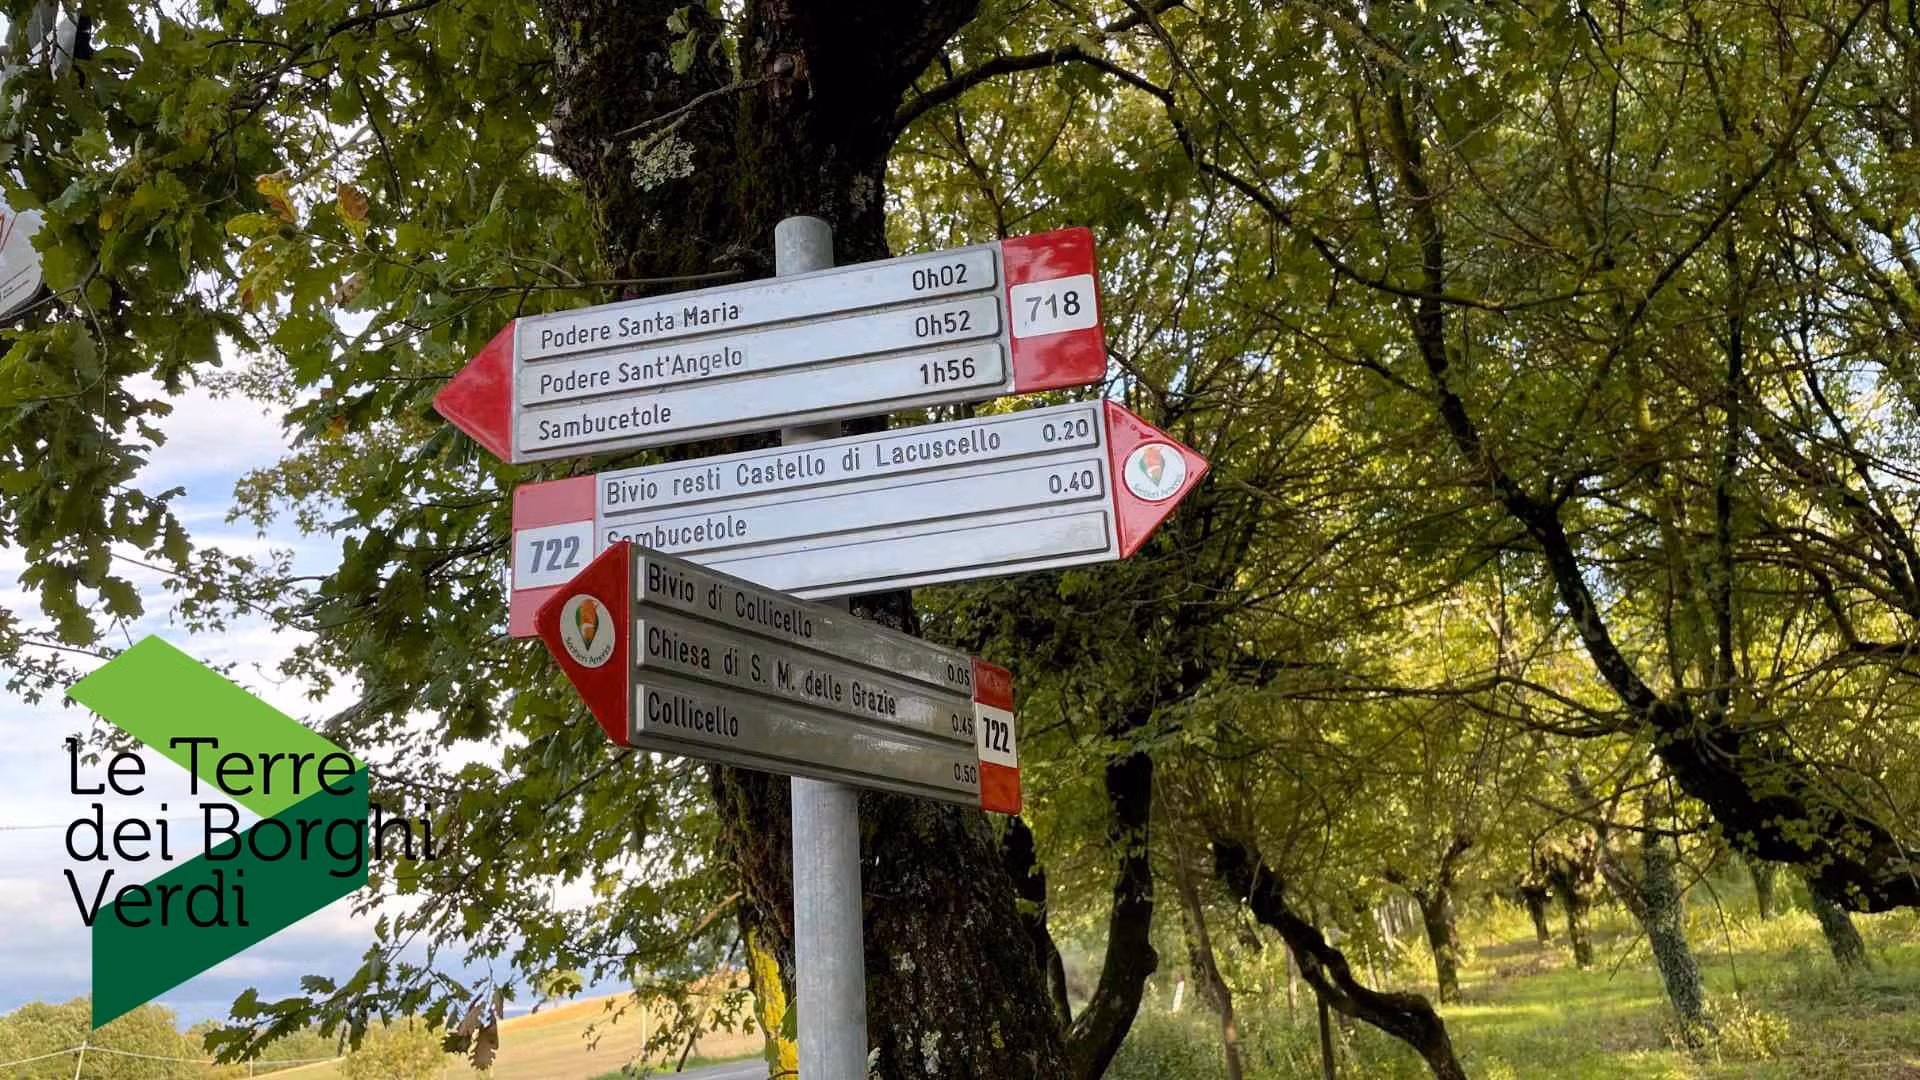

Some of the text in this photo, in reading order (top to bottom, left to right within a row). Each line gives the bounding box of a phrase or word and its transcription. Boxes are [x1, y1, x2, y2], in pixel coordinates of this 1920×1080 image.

[912, 263, 968, 291] 0h02
[915, 310, 971, 338] 0h52
[1025, 291, 1081, 323] 718
[541, 302, 740, 350] Podere Santa Maria
[540, 348, 742, 395] Podere Sant'Angelo
[920, 357, 976, 385] 1h56
[538, 404, 672, 441] Sambucetole
[1042, 418, 1089, 442] 0.20
[607, 428, 1001, 505] Bivio resti Castello di Lacuscello
[1049, 470, 1094, 494] 0.40
[530, 535, 580, 574] 722
[648, 563, 812, 639] Bivio di Collicello
[649, 628, 711, 670] Chiesa
[724, 648, 738, 676] di
[751, 654, 767, 684] S.
[778, 661, 796, 691] M.
[805, 670, 842, 702] delle
[852, 682, 897, 716] Grazie
[947, 664, 970, 686] 0.05
[649, 692, 739, 737] Collicello
[952, 713, 974, 736] 0.45
[983, 717, 1010, 753] 722
[953, 763, 977, 784] 0.50
